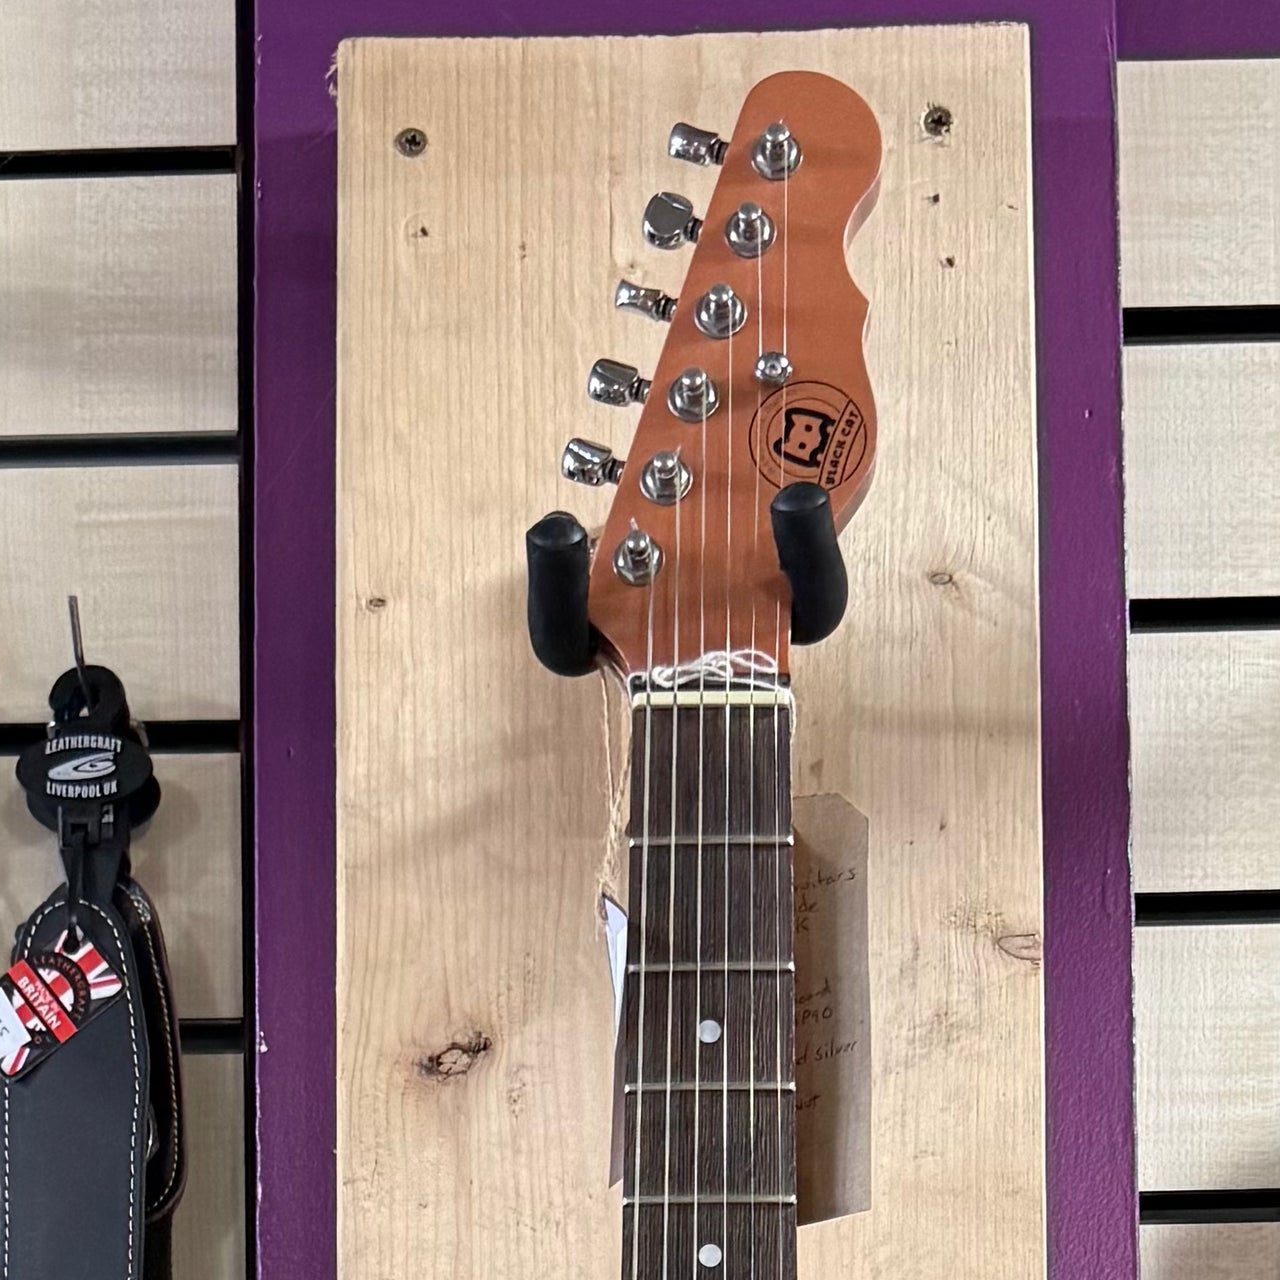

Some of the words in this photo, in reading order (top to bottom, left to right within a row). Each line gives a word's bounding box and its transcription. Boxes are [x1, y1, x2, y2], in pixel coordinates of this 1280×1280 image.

[44, 735, 122, 755] LEATHERCRAFT
[46, 780, 101, 799] LIVERPOOL
[103, 779, 118, 796] UK
[795, 867, 856, 893] uitars
[17, 975, 62, 1030] BRITAIN
